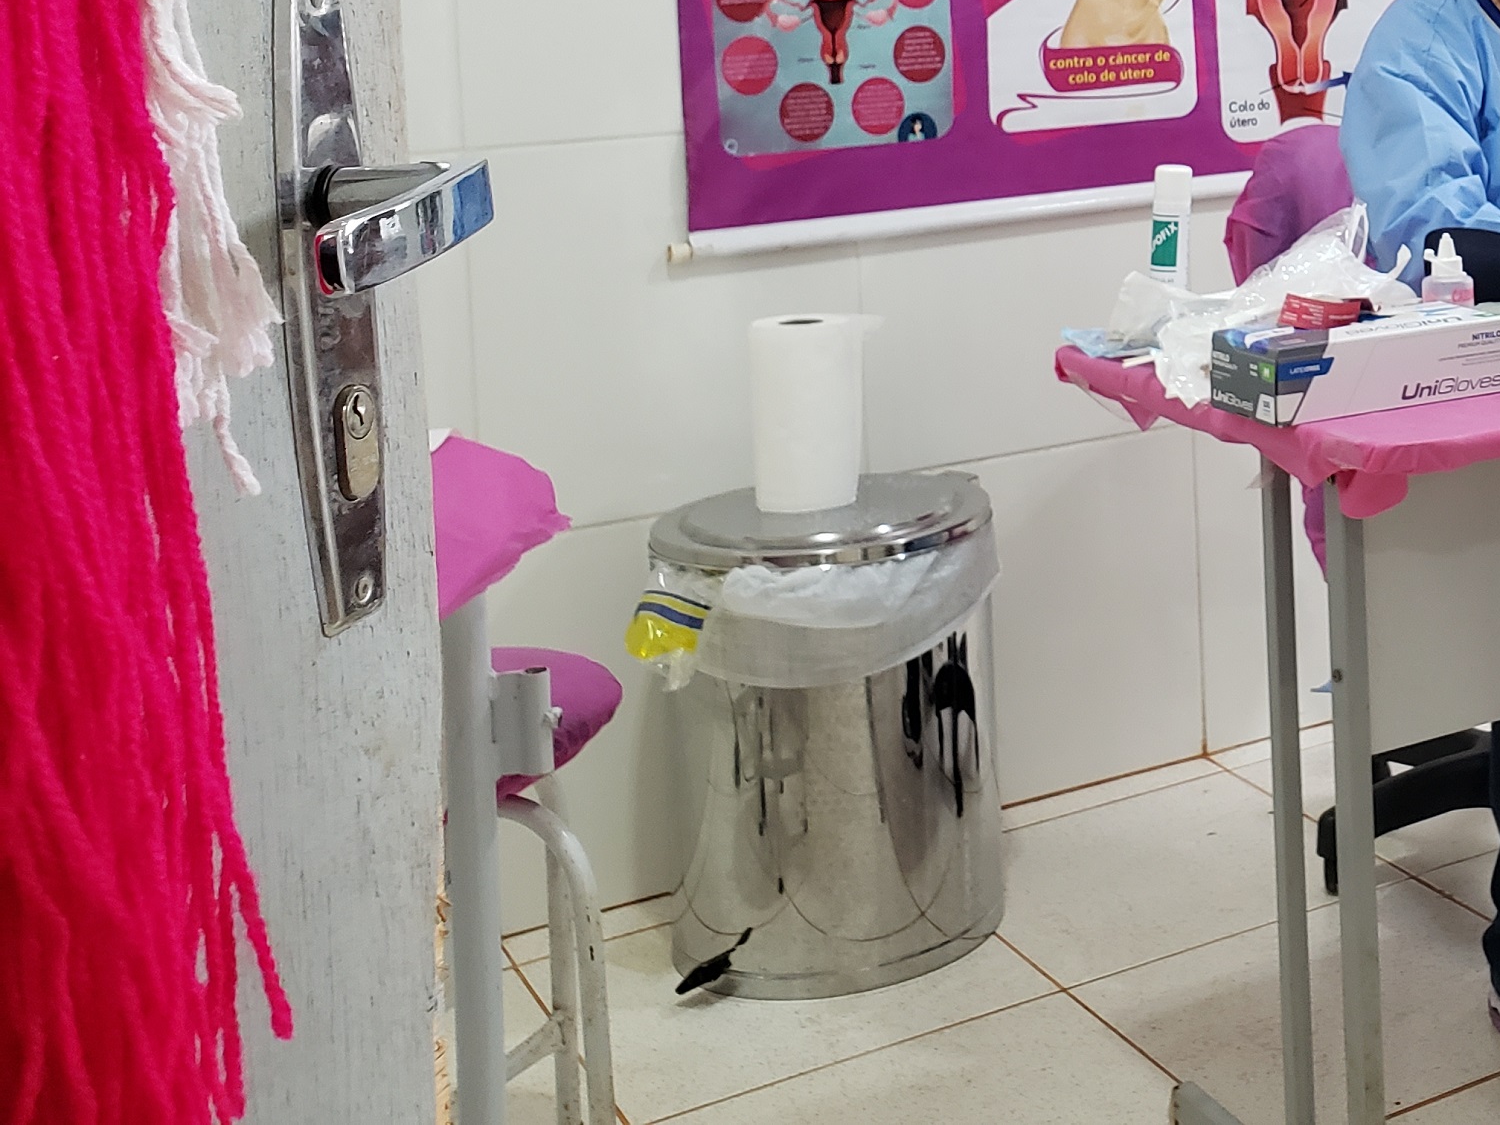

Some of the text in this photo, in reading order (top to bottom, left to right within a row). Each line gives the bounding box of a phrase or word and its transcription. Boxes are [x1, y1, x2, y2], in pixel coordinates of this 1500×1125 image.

[1049, 49, 1171, 70] contra o câncer de
[1068, 66, 1154, 85] colo de útero
[1229, 100, 1270, 114] Colo do
[1229, 116, 1258, 128] útero
